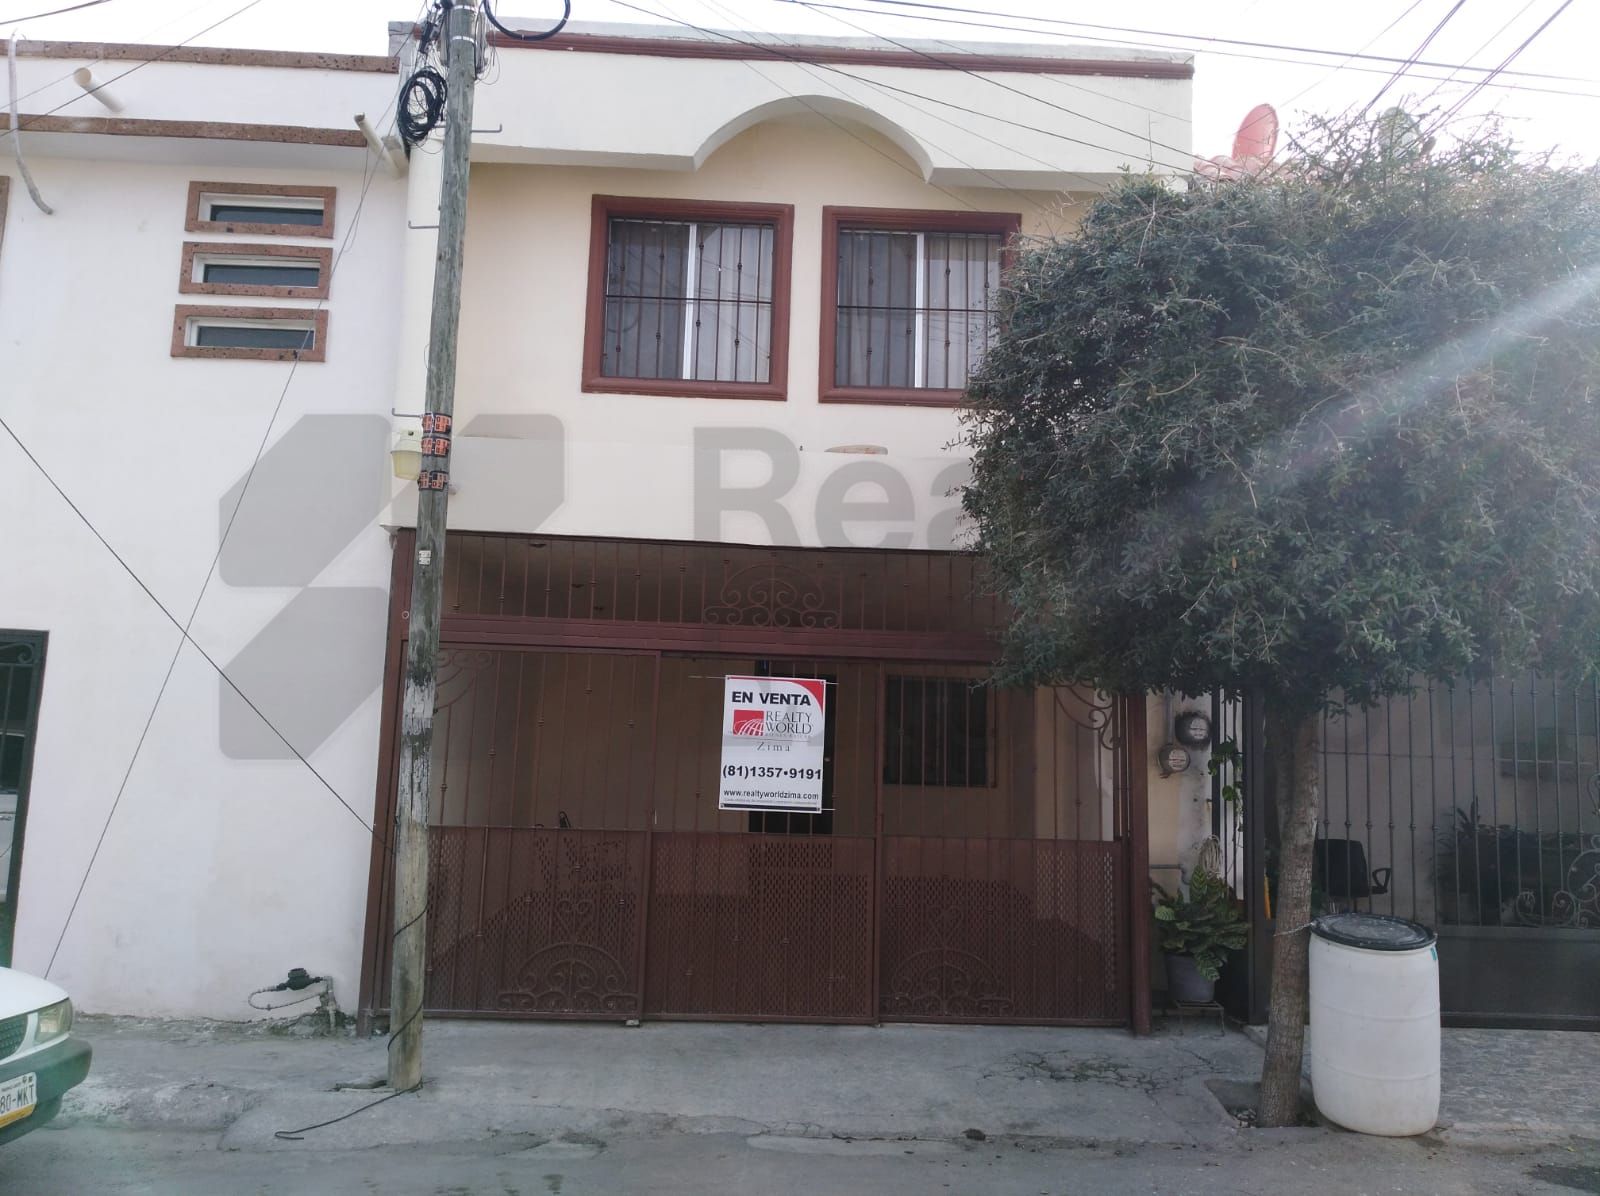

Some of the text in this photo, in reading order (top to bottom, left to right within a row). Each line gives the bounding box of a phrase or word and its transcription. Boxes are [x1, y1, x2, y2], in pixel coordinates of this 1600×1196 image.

[732, 691, 811, 706] EN VENTA
[766, 711, 812, 723] REALTY
[765, 722, 812, 735] WORLD
[757, 741, 791, 752] Zima
[723, 789, 819, 800] www.realtyworldzima.com
